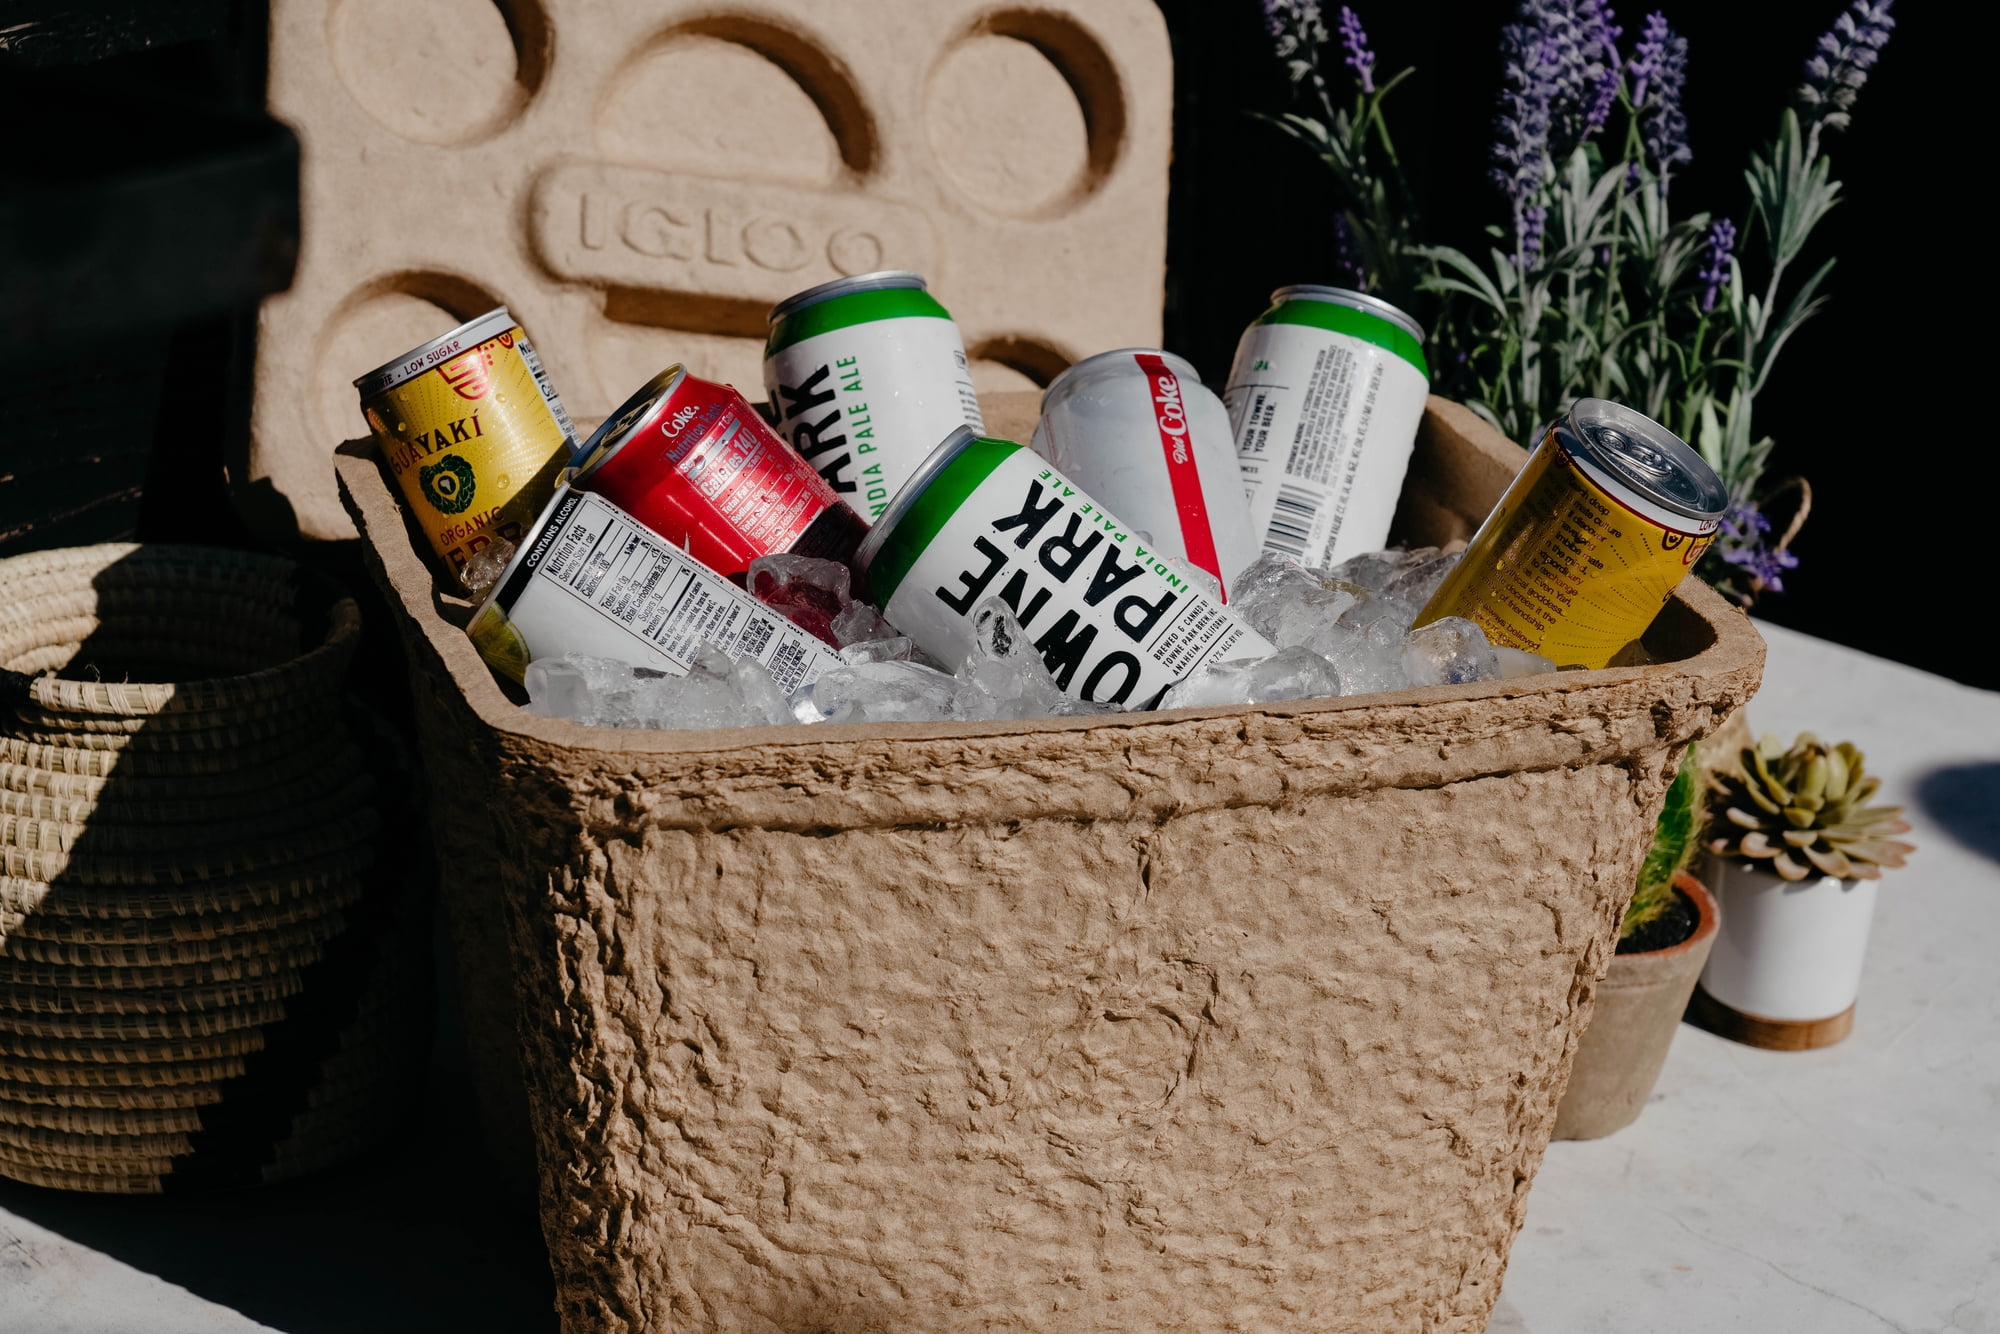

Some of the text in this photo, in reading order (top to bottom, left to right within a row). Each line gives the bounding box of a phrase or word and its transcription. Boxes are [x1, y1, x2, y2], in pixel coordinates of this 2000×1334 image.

[577, 192, 885, 277] IGLOO
[404, 340, 461, 375] LOW SUGAR
[661, 406, 698, 438] Coke
[779, 364, 858, 494] ARK
[836, 356, 889, 521] NDIA PALE ALE
[1156, 376, 1189, 465] Diet Coke
[1241, 389, 1267, 452] YOUR TOWNE.
[1253, 400, 1276, 453] YOUR BEER.
[389, 408, 484, 475] GUAYAKÍ
[698, 426, 759, 497] Calories 140
[721, 495, 740, 515] Total
[735, 485, 749, 499] Fat
[730, 498, 755, 524] Sodium
[1571, 499, 1623, 538] mate culture
[1586, 496, 1611, 517] deep
[440, 506, 504, 546] ORGANIC
[526, 496, 579, 568] CONTAINS ALCOHOL
[739, 514, 757, 533] Total
[1038, 469, 1190, 594] INDIA PALE ALE
[1570, 515, 1609, 543] discover
[545, 522, 587, 576] Nutrition Facts
[558, 558, 580, 583] Serving
[573, 545, 587, 560] Size
[584, 532, 596, 544] can
[991, 479, 1178, 643] PARK
[1550, 543, 1589, 576] the mind,
[1553, 531, 1605, 569] imbibe mate
[574, 572, 588, 591] Amount
[589, 550, 604, 568] Serving
[581, 558, 610, 598] Calorie 100
[1530, 557, 1541, 568] to
[1536, 566, 1580, 598] exchange
[1532, 575, 1556, 594] Even
[601, 592, 617, 610] Total
[611, 582, 623, 595] Fat
[618, 574, 629, 585] 0g
[611, 591, 632, 617] Sodium
[626, 578, 641, 595] 5mg
[621, 605, 637, 624] Total
[632, 569, 661, 609] Carbohydrate
[638, 591, 662, 622] Sugars 1g
[1502, 583, 1557, 624] decrees it the
[642, 612, 661, 637] Protein
[655, 604, 668, 616] 0g
[935, 536, 1166, 710] OWNE
[1151, 599, 1209, 661] BREWED & CANNED BY
[1498, 593, 1549, 633] of friendship.
[657, 635, 667, 646] Not
[666, 639, 678, 652] from
[1160, 642, 1186, 668] TOWNE
[1180, 627, 1199, 646] PARK
[1169, 614, 1228, 676] ANAHEIM, CALIFORNIA
[1219, 640, 1232, 652] ALC
[1228, 634, 1237, 643] BY
[1504, 623, 1541, 651] believed
